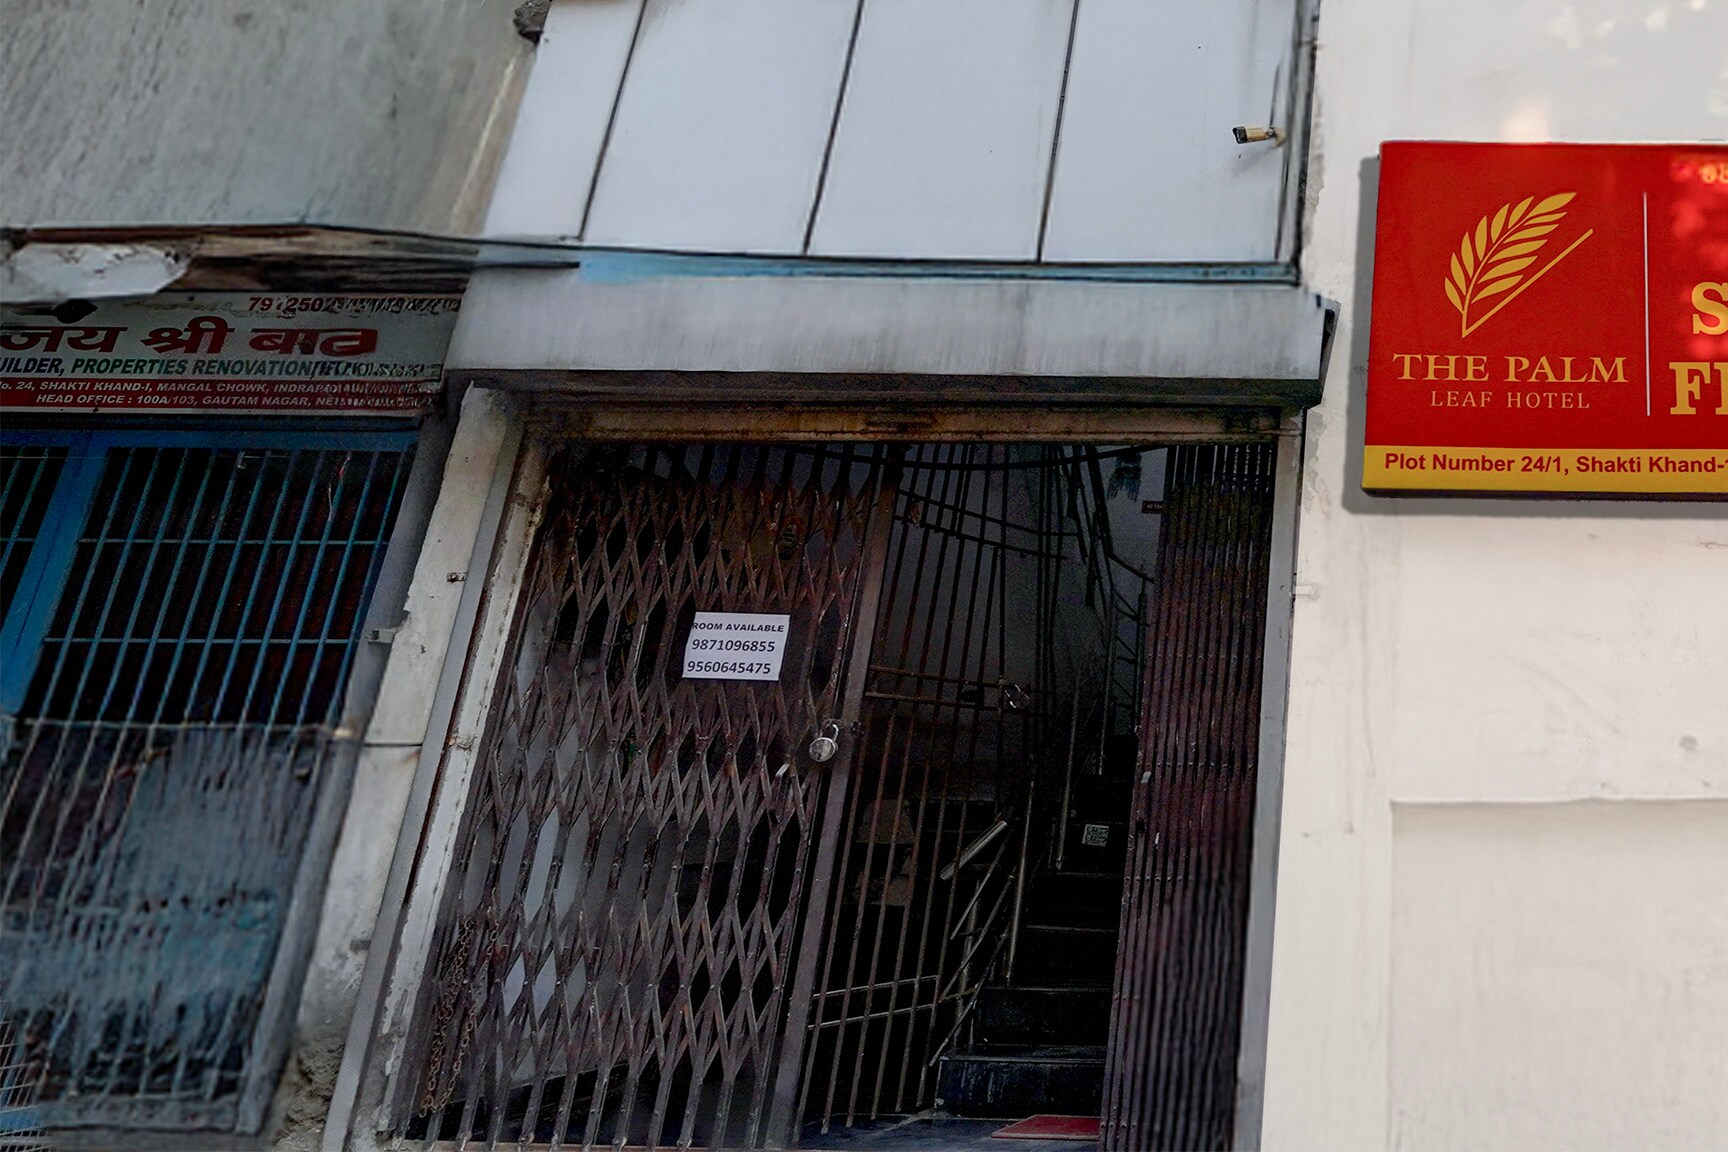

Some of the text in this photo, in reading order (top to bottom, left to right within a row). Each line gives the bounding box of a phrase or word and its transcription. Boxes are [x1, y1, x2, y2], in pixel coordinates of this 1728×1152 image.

[140, 315, 236, 355] श्री
[71, 357, 187, 376] PROPERTIES
[1393, 353, 1628, 383] THE PALM
[16, 381, 36, 392] 24,
[40, 381, 91, 391] SHAKTI
[156, 383, 214, 393] MANGAL
[216, 383, 271, 395] CHOWK,
[36, 394, 75, 404] HEAD
[77, 394, 126, 405] OFFICE
[136, 394, 201, 406] 100A/103,
[202, 395, 257, 406] GAUTAM
[259, 395, 313, 407] NAGAR,
[1431, 391, 1590, 409] LEAF HOTEL
[1385, 453, 1426, 470] Plot
[1433, 454, 1515, 471] Number
[1521, 456, 1568, 476] 24/1,
[1576, 456, 1641, 473] Shakti
[692, 622, 785, 633] ROOM AVAILABLE
[692, 639, 775, 652] 9871096855
[687, 661, 771, 674] 9560645475
